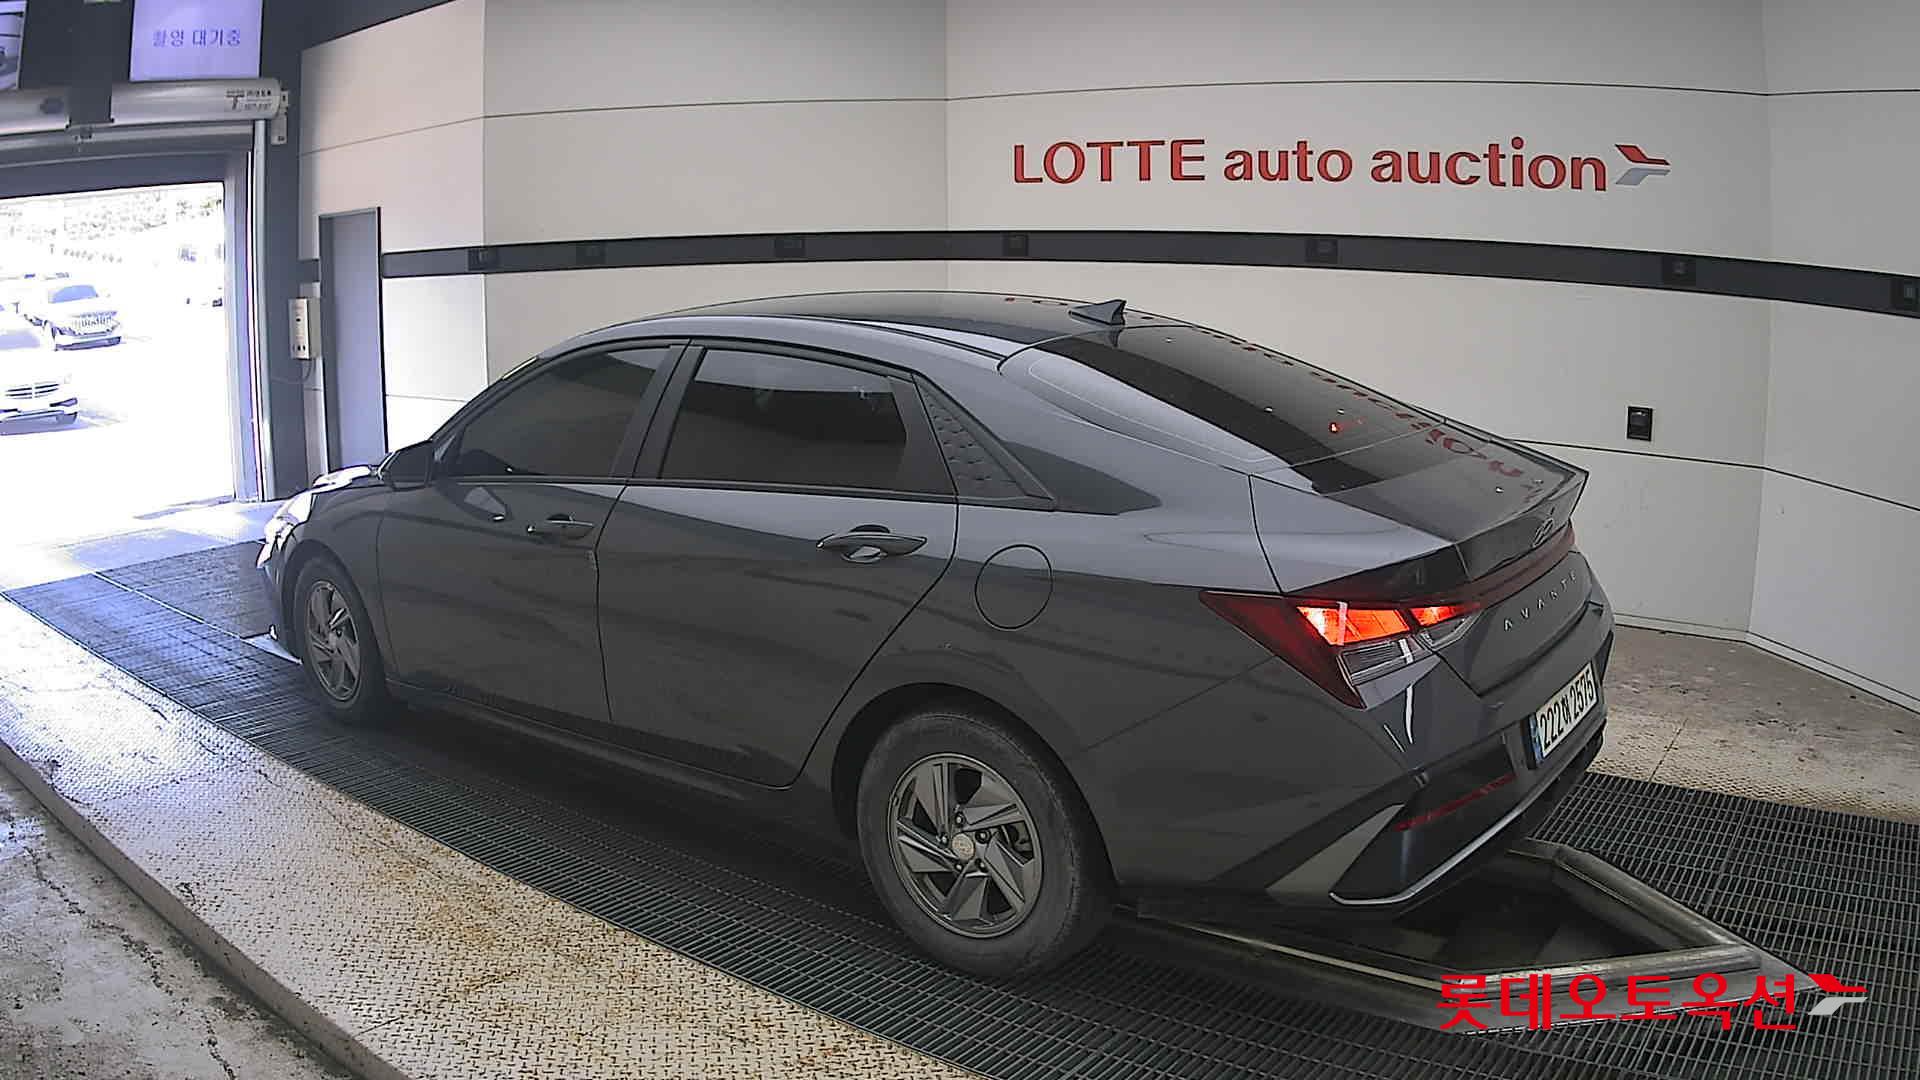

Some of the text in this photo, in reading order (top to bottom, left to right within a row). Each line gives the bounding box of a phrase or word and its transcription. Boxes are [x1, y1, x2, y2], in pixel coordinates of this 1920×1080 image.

[192, 28, 240, 48] 대기중
[1014, 136, 1607, 192] LOTTE auto auction
[1504, 570, 1576, 631] AVANTE
